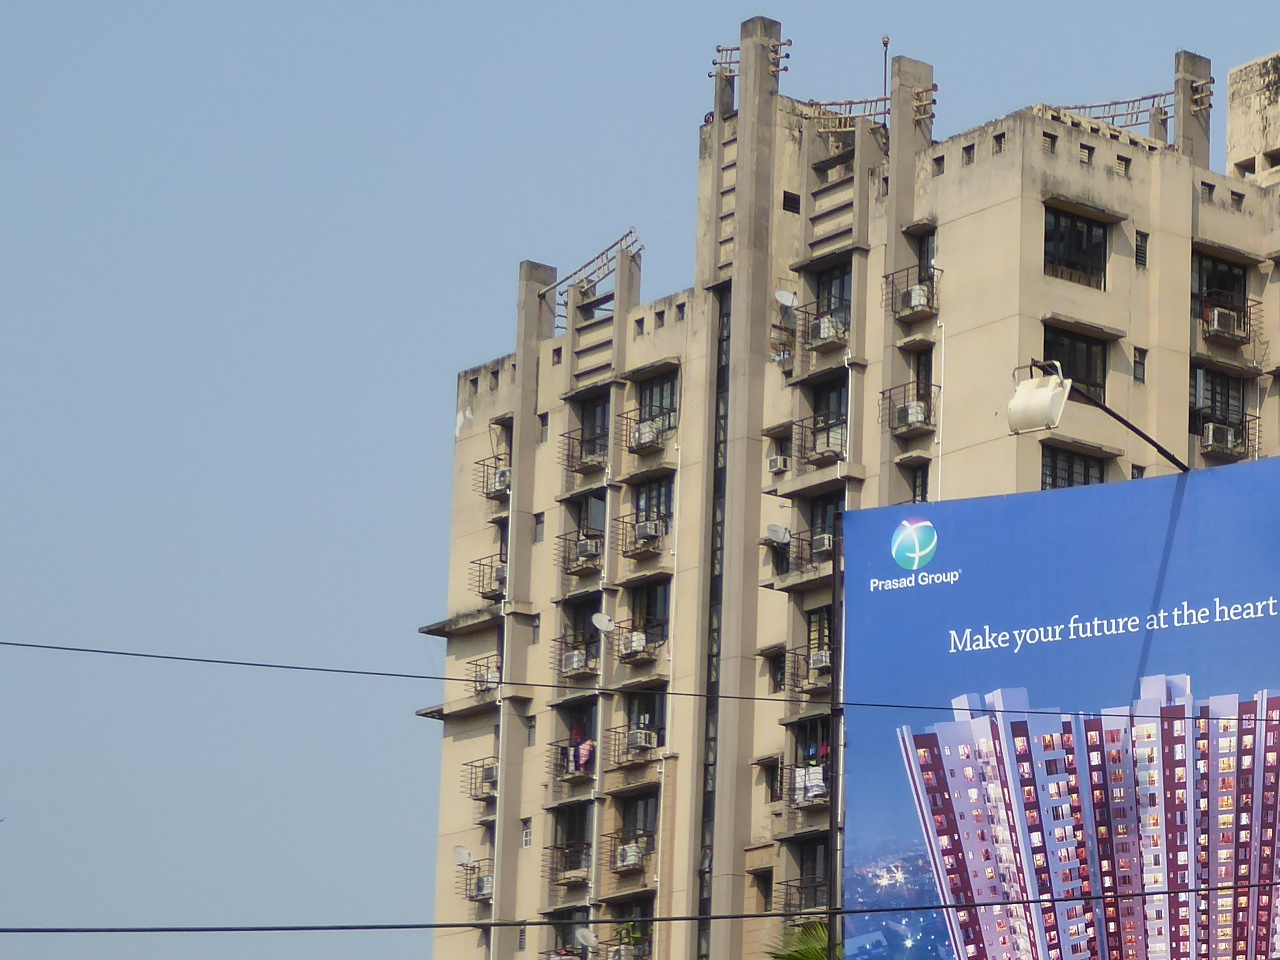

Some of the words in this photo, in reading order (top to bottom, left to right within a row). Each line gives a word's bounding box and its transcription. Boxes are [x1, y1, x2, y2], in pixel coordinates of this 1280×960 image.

[870, 574, 915, 592] Prasad
[949, 628, 1009, 653] Make
[1013, 623, 1062, 653] your
[1068, 611, 1140, 640] future
[1146, 609, 1168, 630] at
[1172, 603, 1209, 626] the
[1215, 597, 1276, 622] heart
